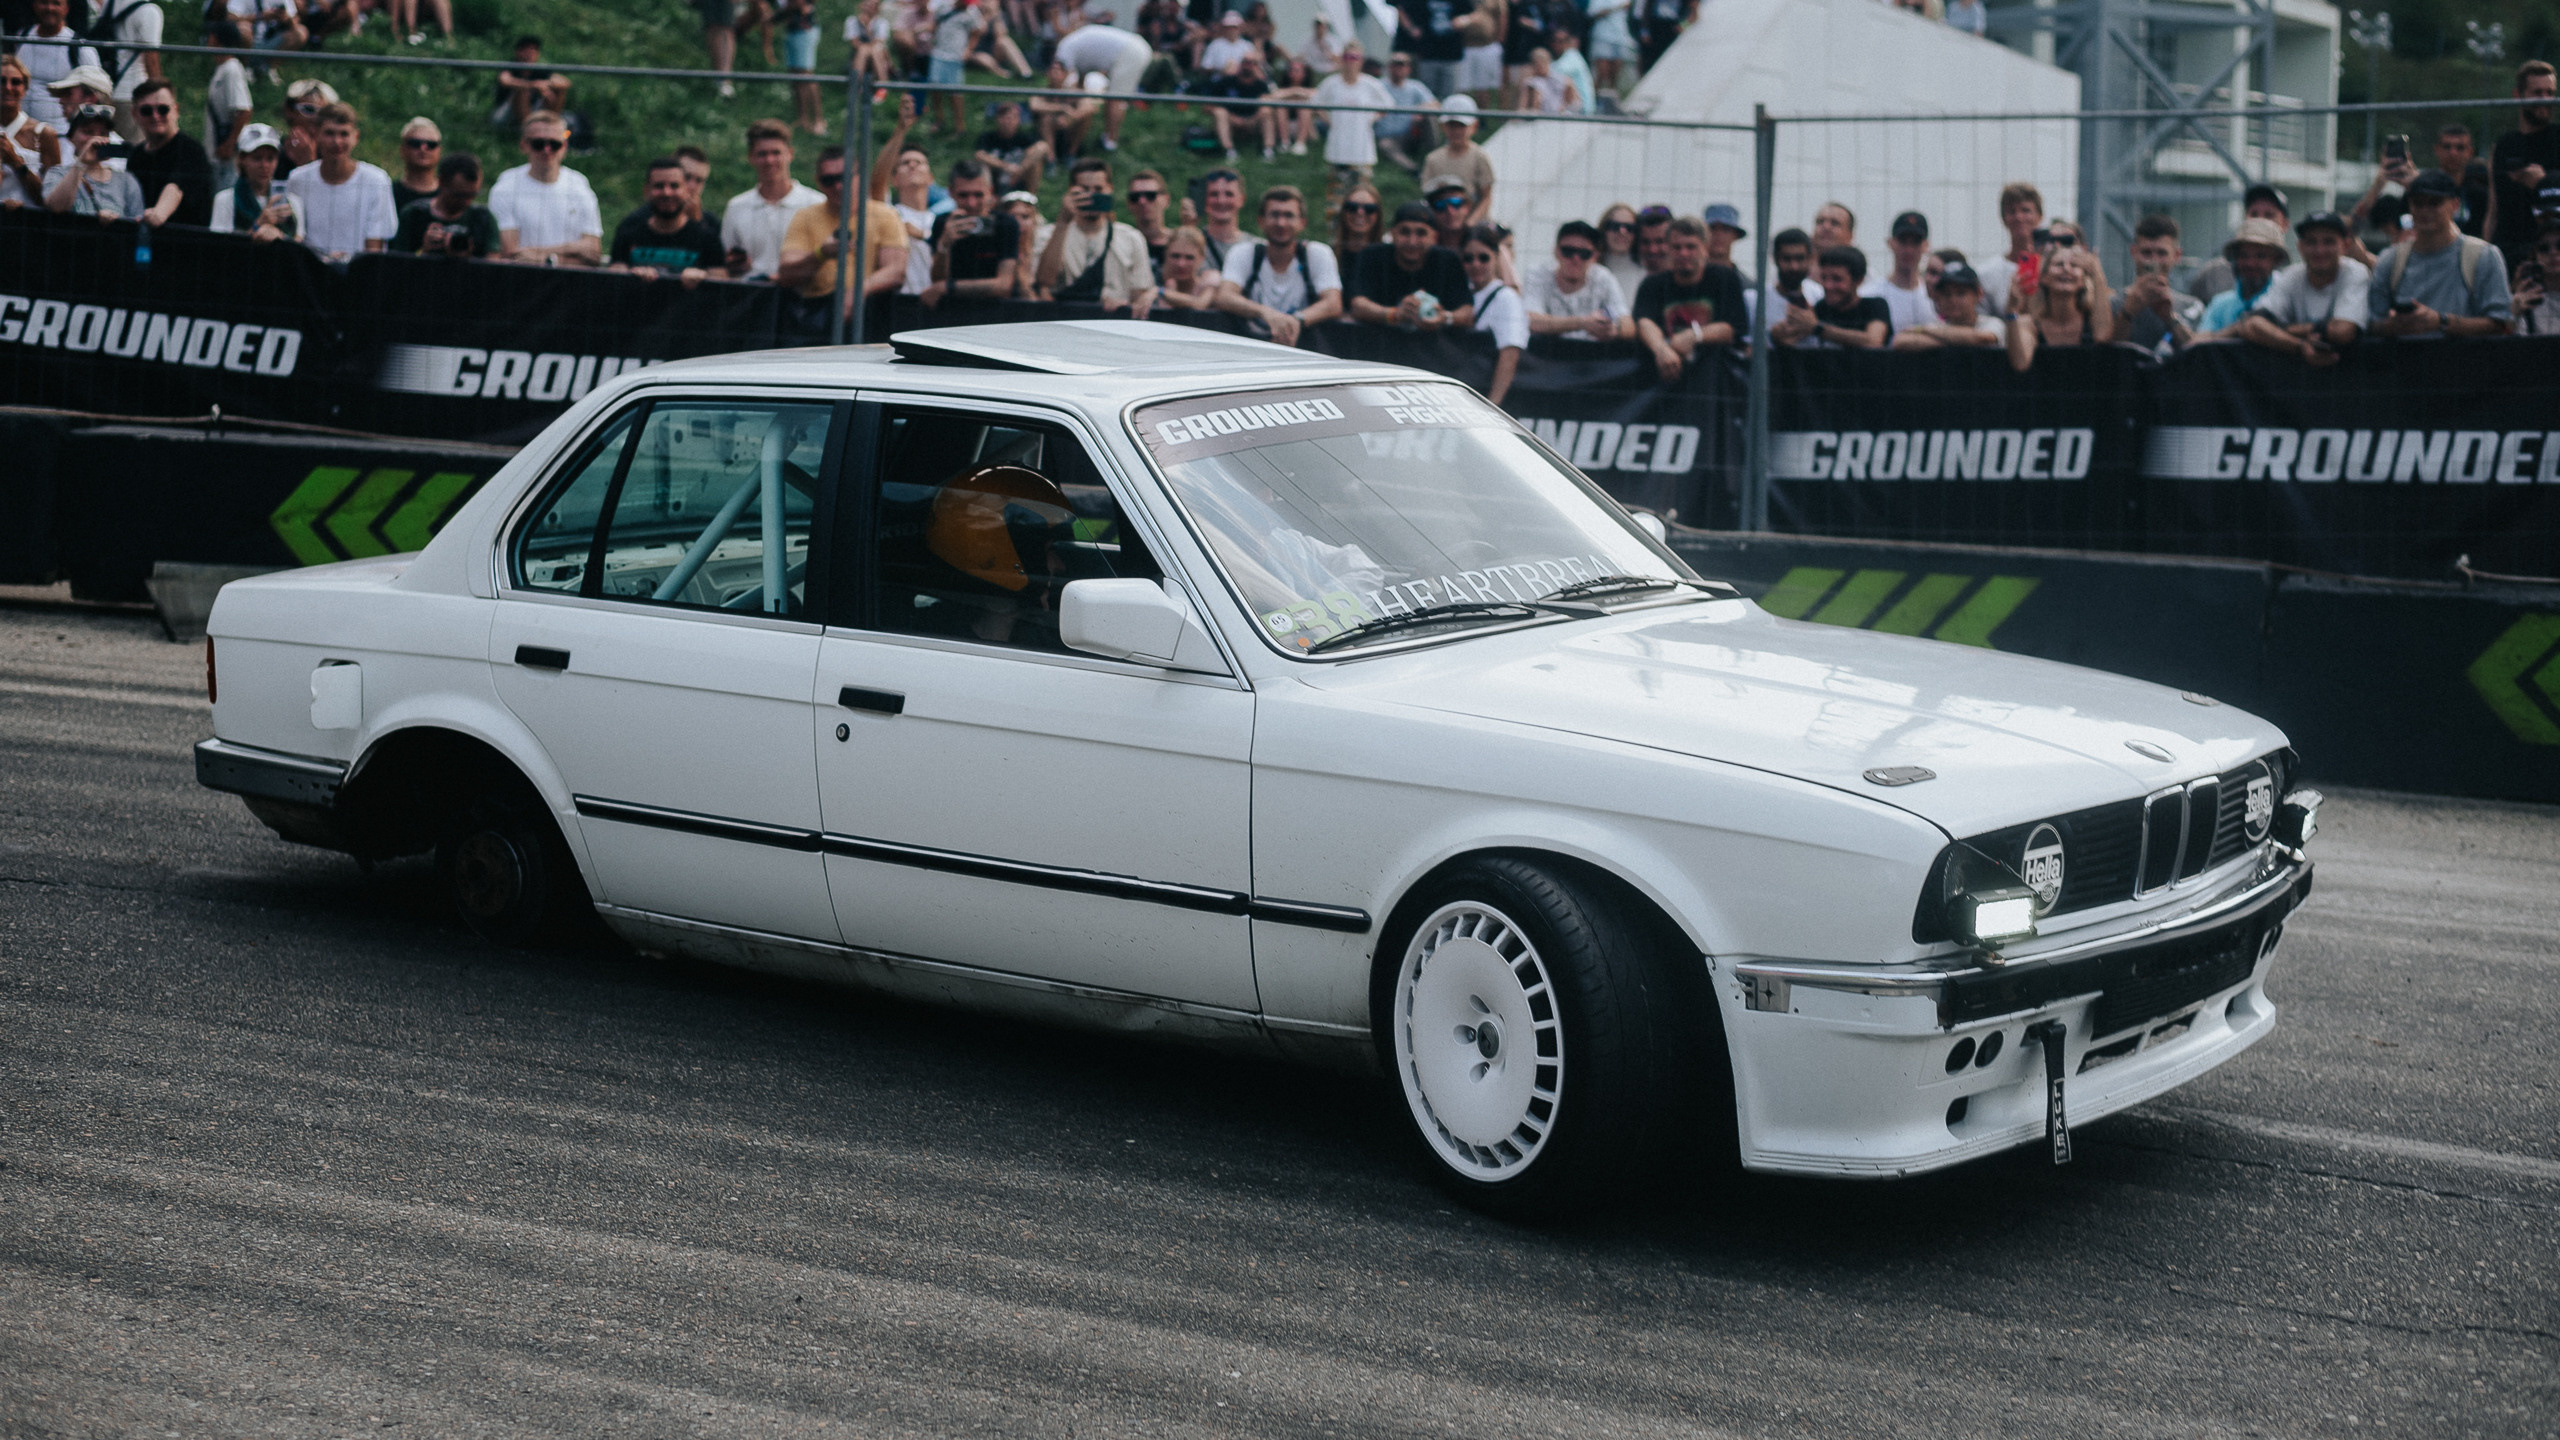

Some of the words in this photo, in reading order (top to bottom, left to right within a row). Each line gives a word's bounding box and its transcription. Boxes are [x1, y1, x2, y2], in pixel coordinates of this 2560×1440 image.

[0, 294, 302, 377] GROUNDED
[1155, 398, 1345, 446] GROUNDED
[1798, 428, 2094, 481] GROUNDED
[2025, 854, 2061, 886] Hella
